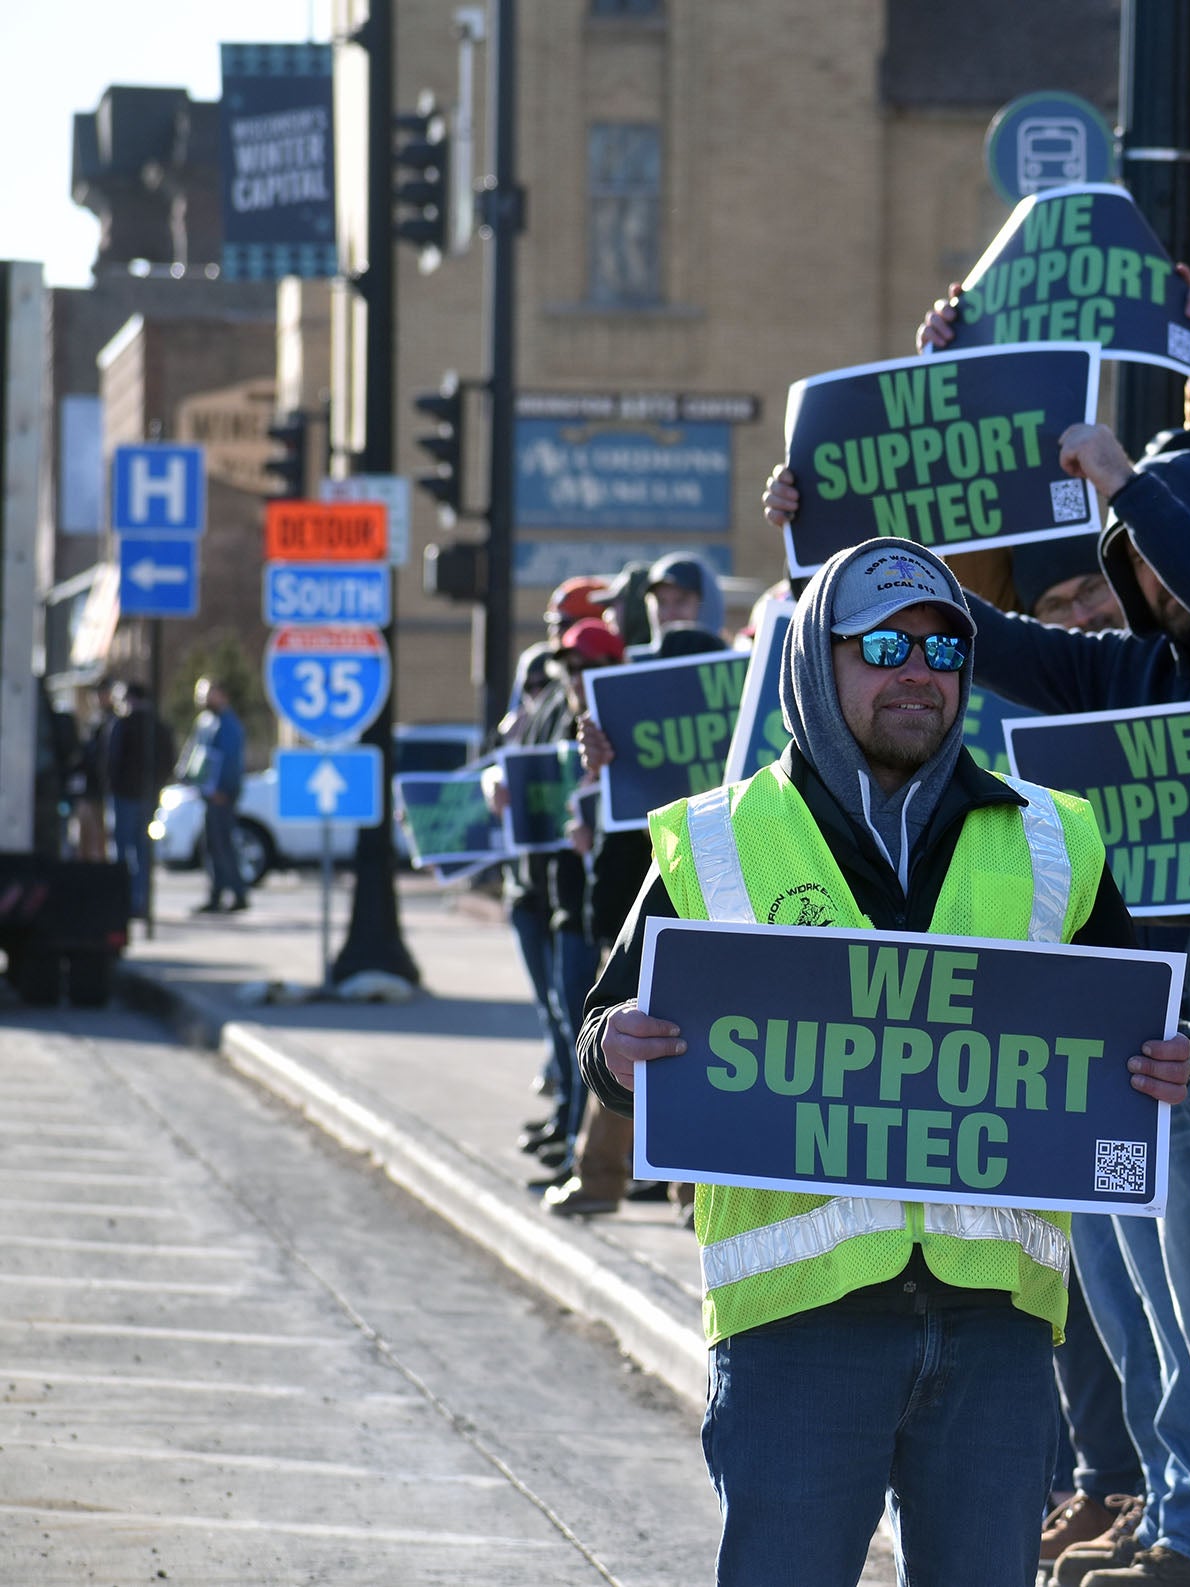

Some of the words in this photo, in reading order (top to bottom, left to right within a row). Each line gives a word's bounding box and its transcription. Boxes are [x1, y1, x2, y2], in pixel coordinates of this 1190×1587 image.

[233, 135, 326, 172] WINTER
[232, 171, 329, 212] CAPITAL
[1024, 194, 1094, 253] WE
[963, 246, 1172, 324] SUPPORT
[994, 297, 1116, 347] NTEC
[879, 363, 961, 429] WE
[813, 410, 1045, 500] SUPPORT
[130, 456, 187, 523] H
[872, 478, 1002, 545] NTEC
[279, 516, 375, 548] DETOUR
[274, 572, 383, 616] SOUTH
[865, 557, 888, 575] IRON
[877, 580, 914, 591] LOCAL
[293, 660, 364, 719] 35
[697, 656, 750, 711] W
[632, 712, 738, 769] SUP
[847, 944, 979, 1025] WE
[706, 1014, 1105, 1113] SUPPORT
[795, 1101, 1009, 1190] NTEC
